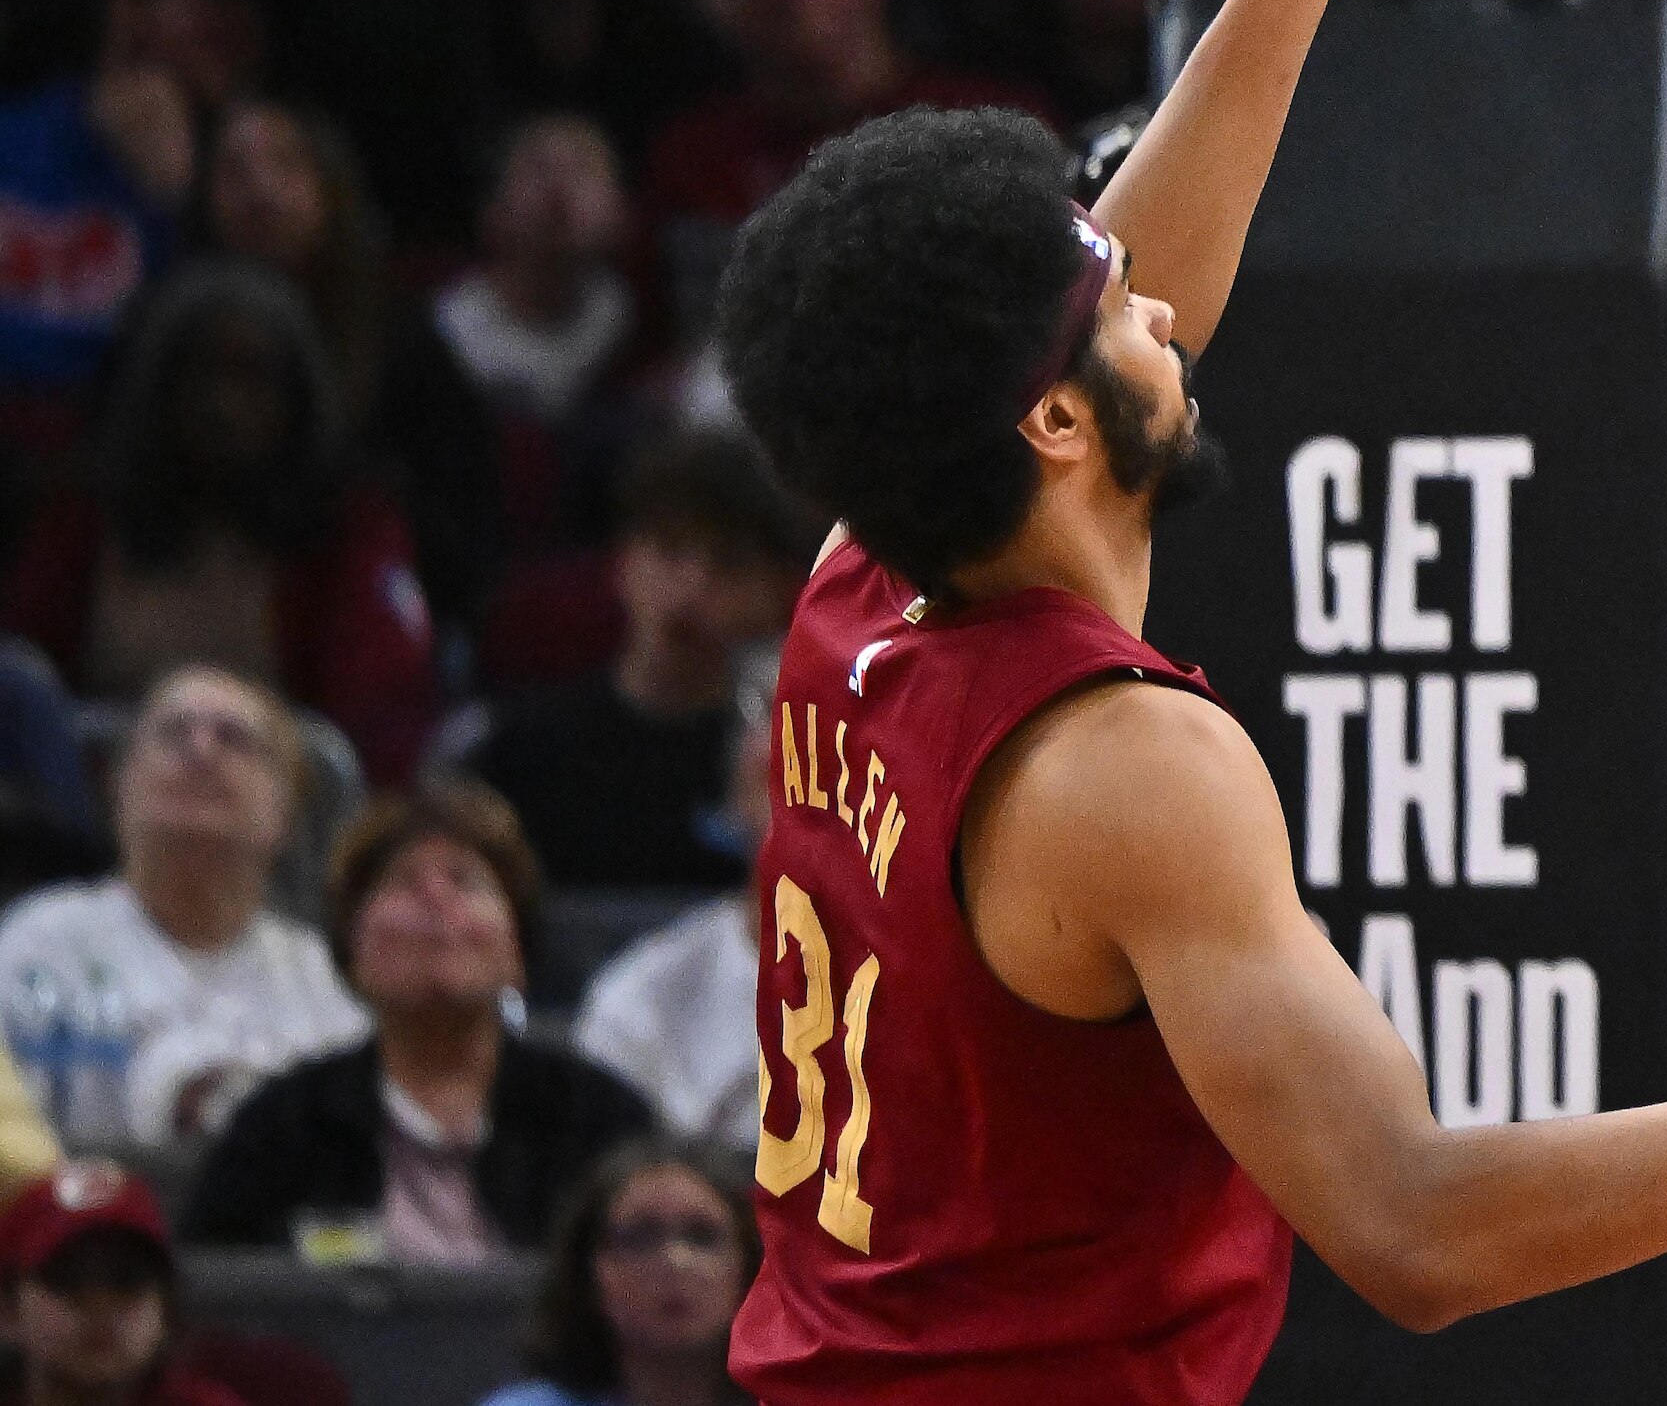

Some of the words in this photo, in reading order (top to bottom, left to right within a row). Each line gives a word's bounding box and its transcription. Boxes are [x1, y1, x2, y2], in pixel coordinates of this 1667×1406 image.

[1286, 435, 1534, 654] GET
[782, 701, 906, 899] ALLEN
[1283, 673, 1539, 888] THE
[755, 874, 880, 1255] 31
